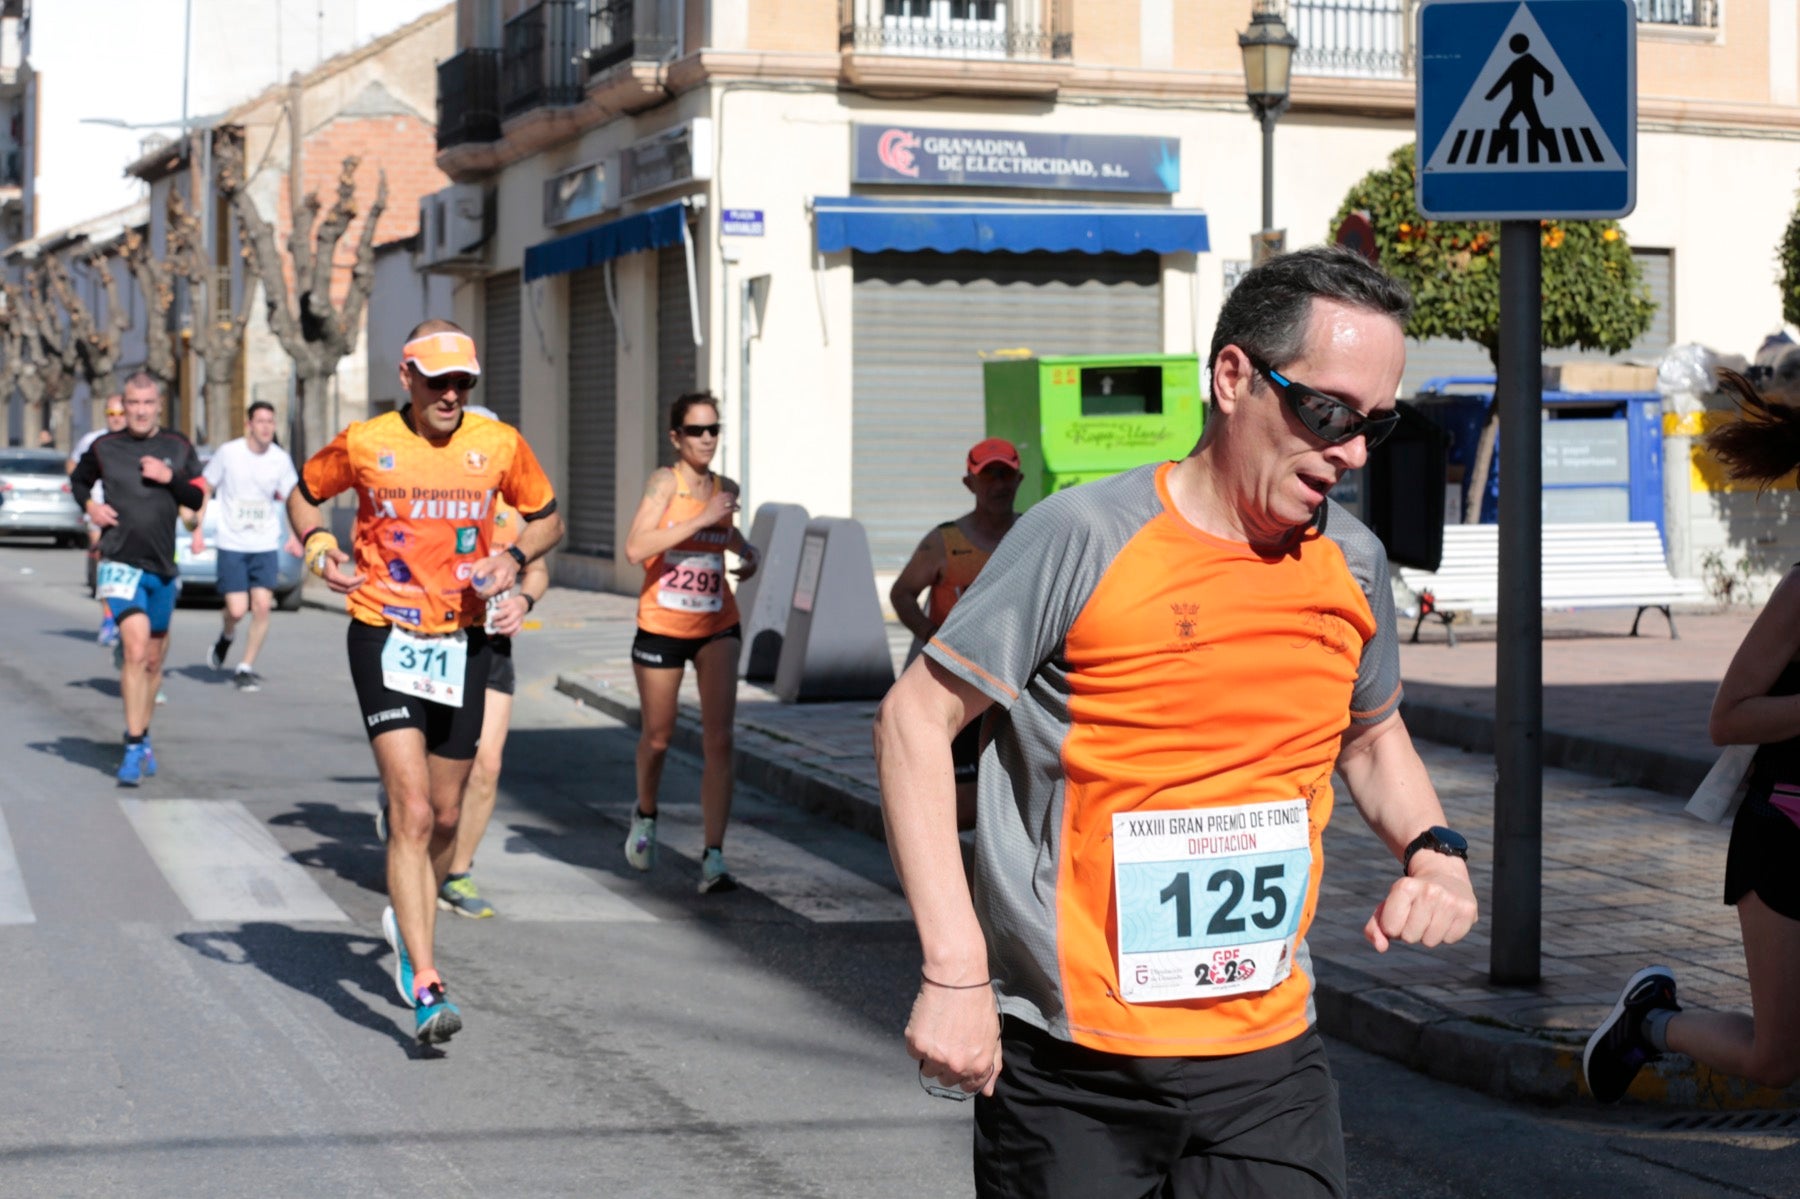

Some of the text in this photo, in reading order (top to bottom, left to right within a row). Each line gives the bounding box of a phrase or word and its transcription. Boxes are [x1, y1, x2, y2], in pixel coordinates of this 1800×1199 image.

[923, 136, 1028, 157] GRANADINA
[938, 154, 963, 171] DE
[966, 155, 1098, 177] ELECTRICIDAD,
[377, 487, 482, 501] Club Deportivo
[665, 567, 721, 594] 2293
[399, 645, 447, 677] 371
[1129, 818, 1165, 837] XXXIII
[1169, 817, 1203, 835] GRAN
[1250, 811, 1264, 828] DE
[1188, 832, 1257, 855] DIPUTACIÓN
[1160, 864, 1287, 938] 125
